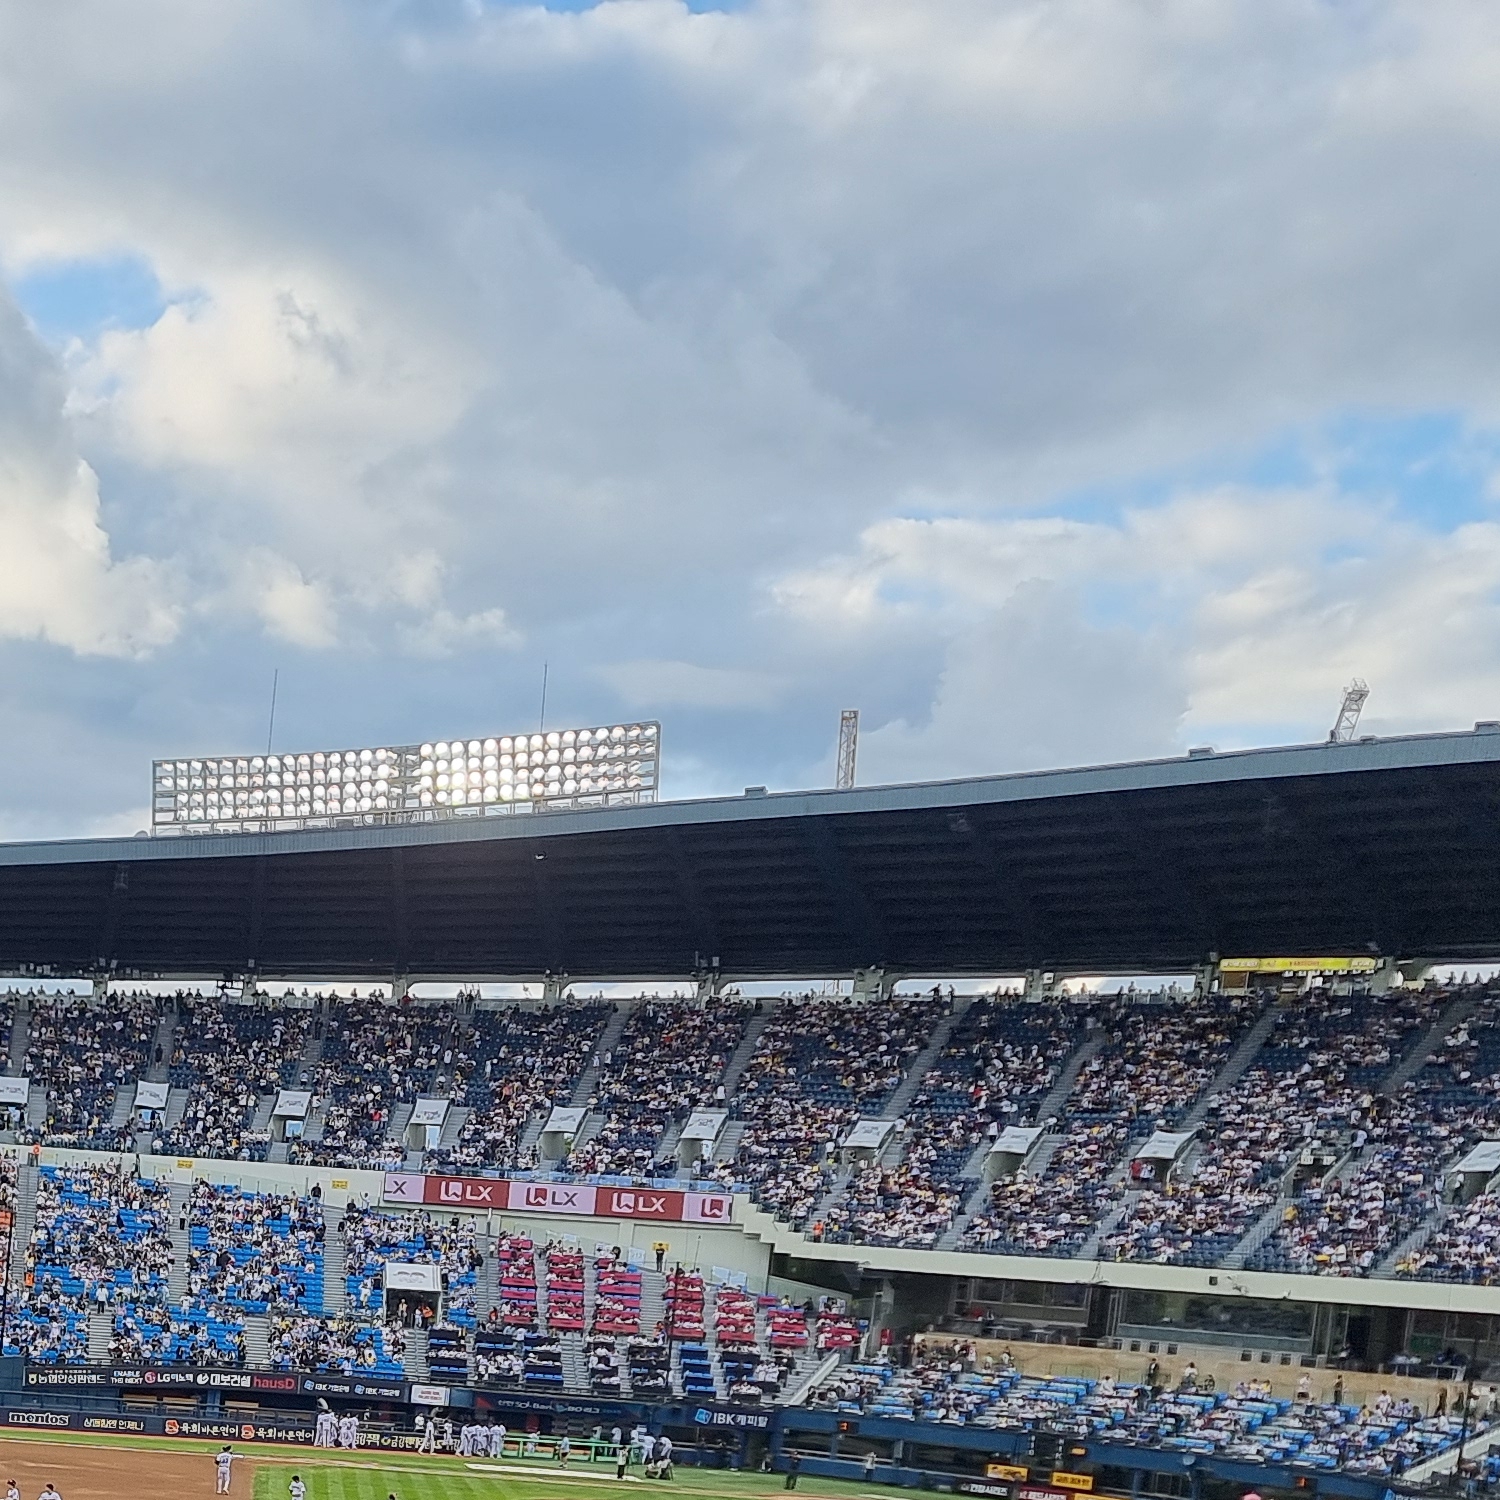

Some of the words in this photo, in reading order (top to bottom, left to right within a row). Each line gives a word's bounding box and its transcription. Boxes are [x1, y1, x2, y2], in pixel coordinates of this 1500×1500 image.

[465, 1185, 494, 1202] LX
[551, 1190, 579, 1207] LX
[637, 1196, 667, 1213] LX
[209, 1373, 251, 1388] 대보건설
[253, 1376, 296, 1389] hausD
[8, 1411, 71, 1426] mentos
[180, 1422, 239, 1438] 육회바른연어
[255, 1427, 315, 1442] 육회바른연어
